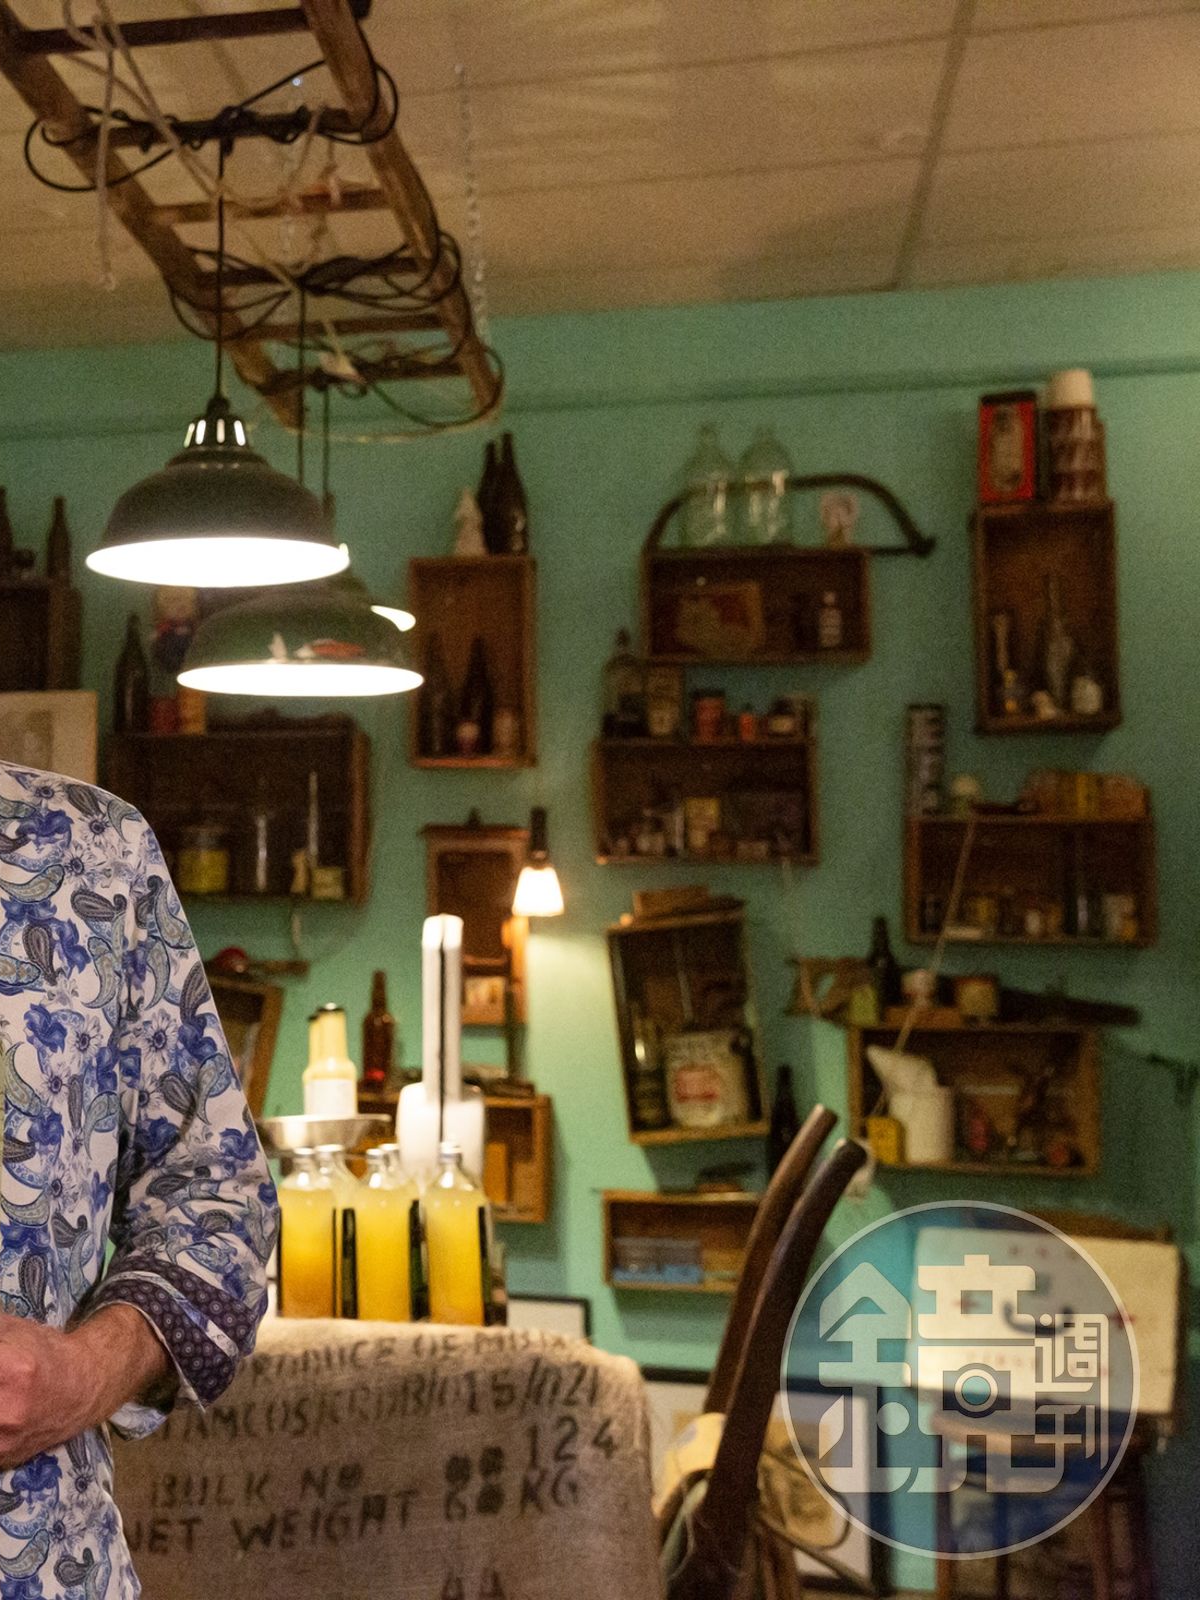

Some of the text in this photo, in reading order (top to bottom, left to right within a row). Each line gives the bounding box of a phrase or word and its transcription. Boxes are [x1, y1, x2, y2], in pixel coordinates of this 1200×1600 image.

[151, 1472, 271, 1509] BULK
[231, 1487, 420, 1552] WEIGHT
[519, 1464, 580, 1519] KG
